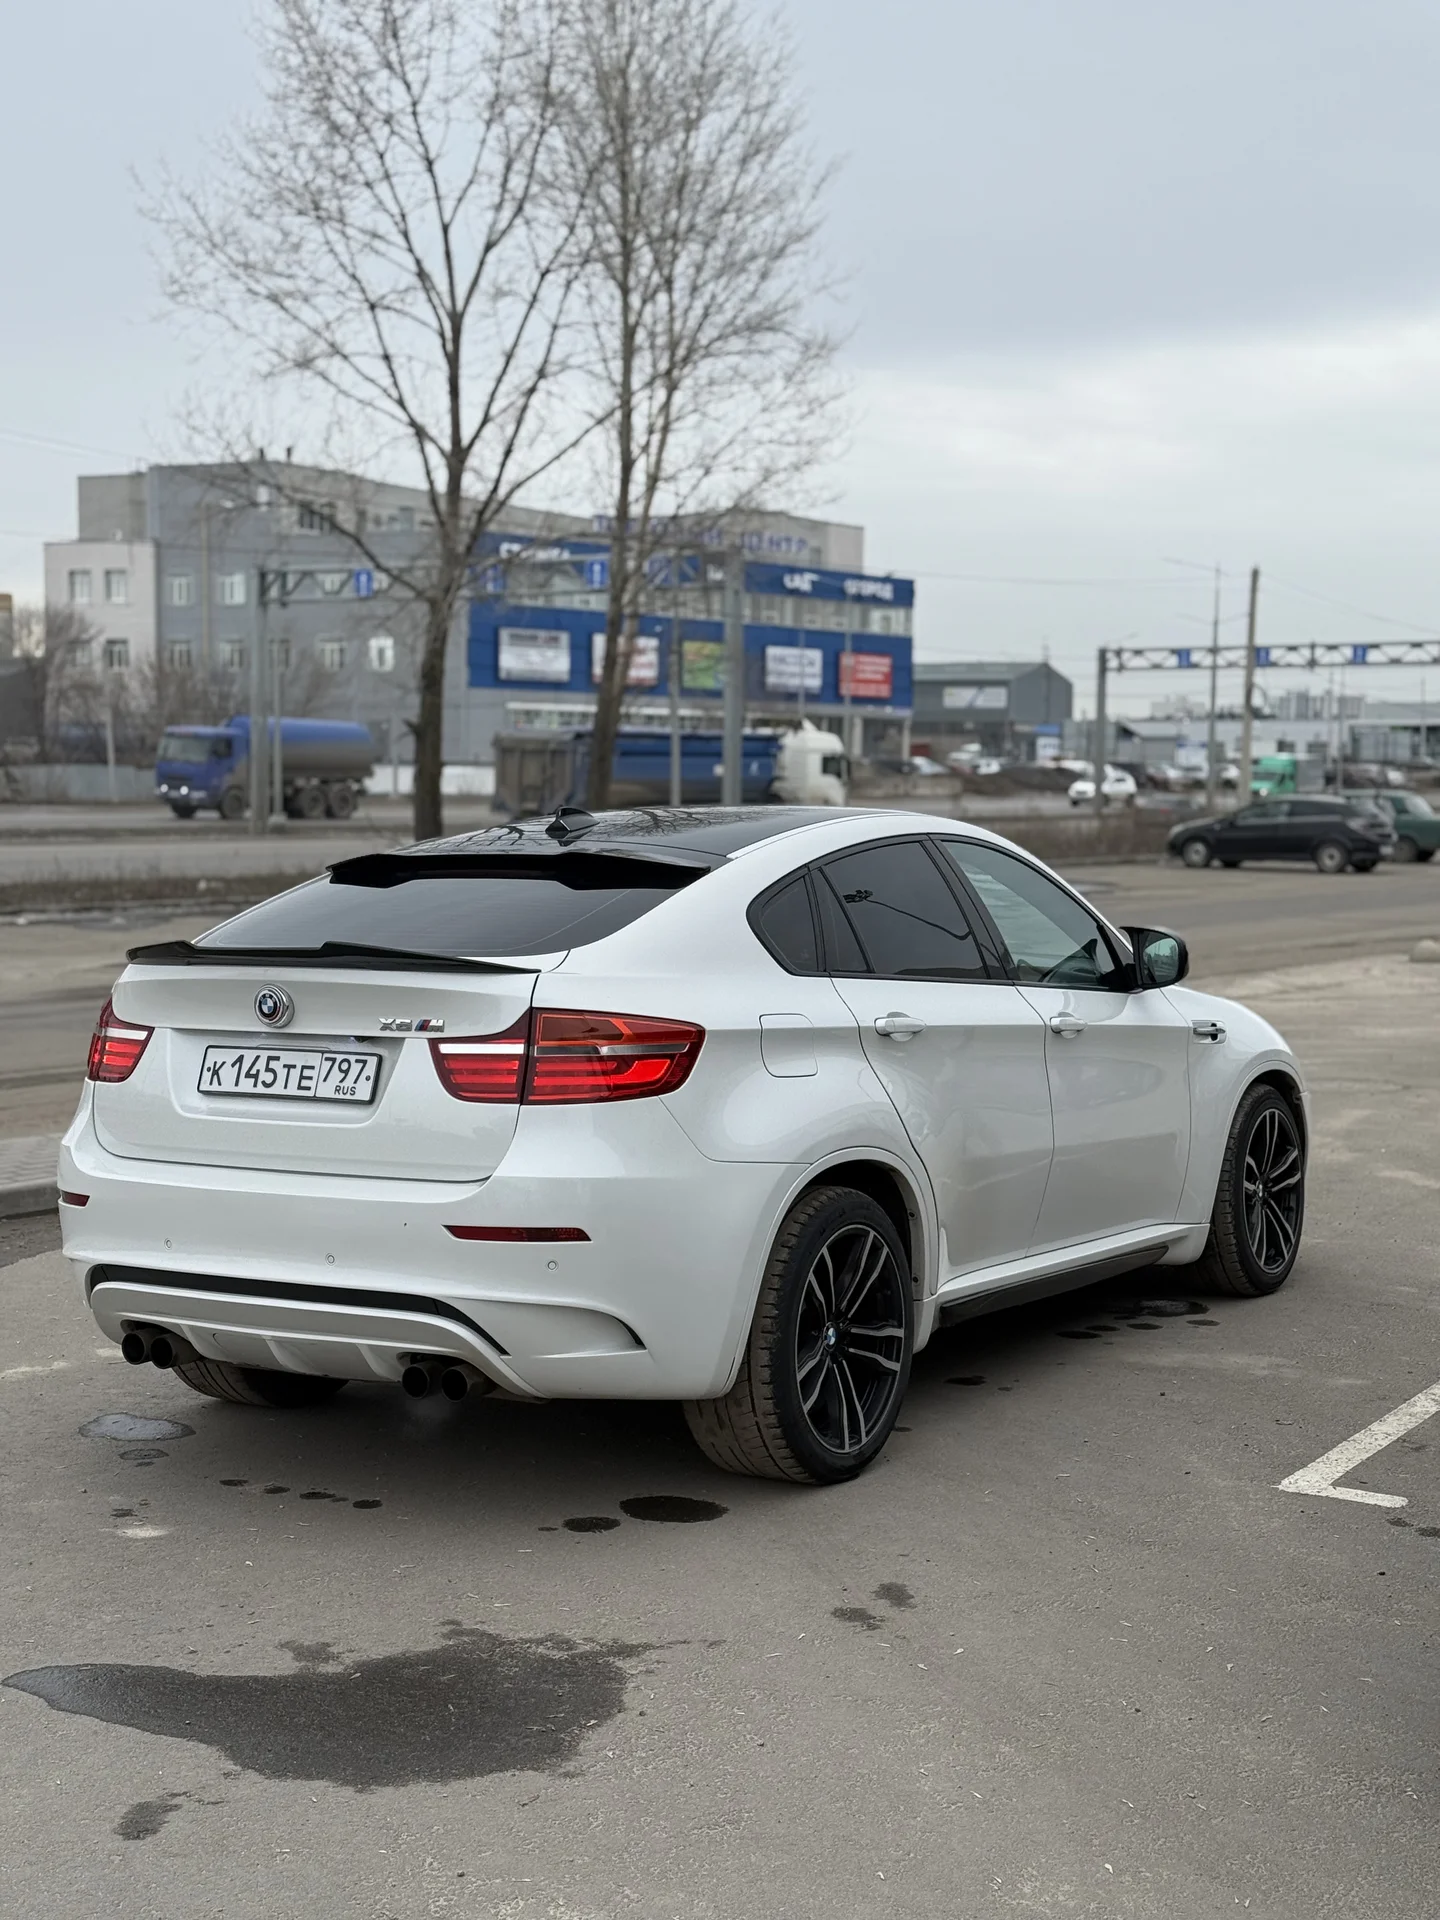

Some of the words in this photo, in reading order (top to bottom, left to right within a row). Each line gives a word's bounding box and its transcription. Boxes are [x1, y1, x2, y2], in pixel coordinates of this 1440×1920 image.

[378, 1017, 413, 1032] X6
[322, 1056, 368, 1085] 797
[334, 1084, 357, 1097] RUS
